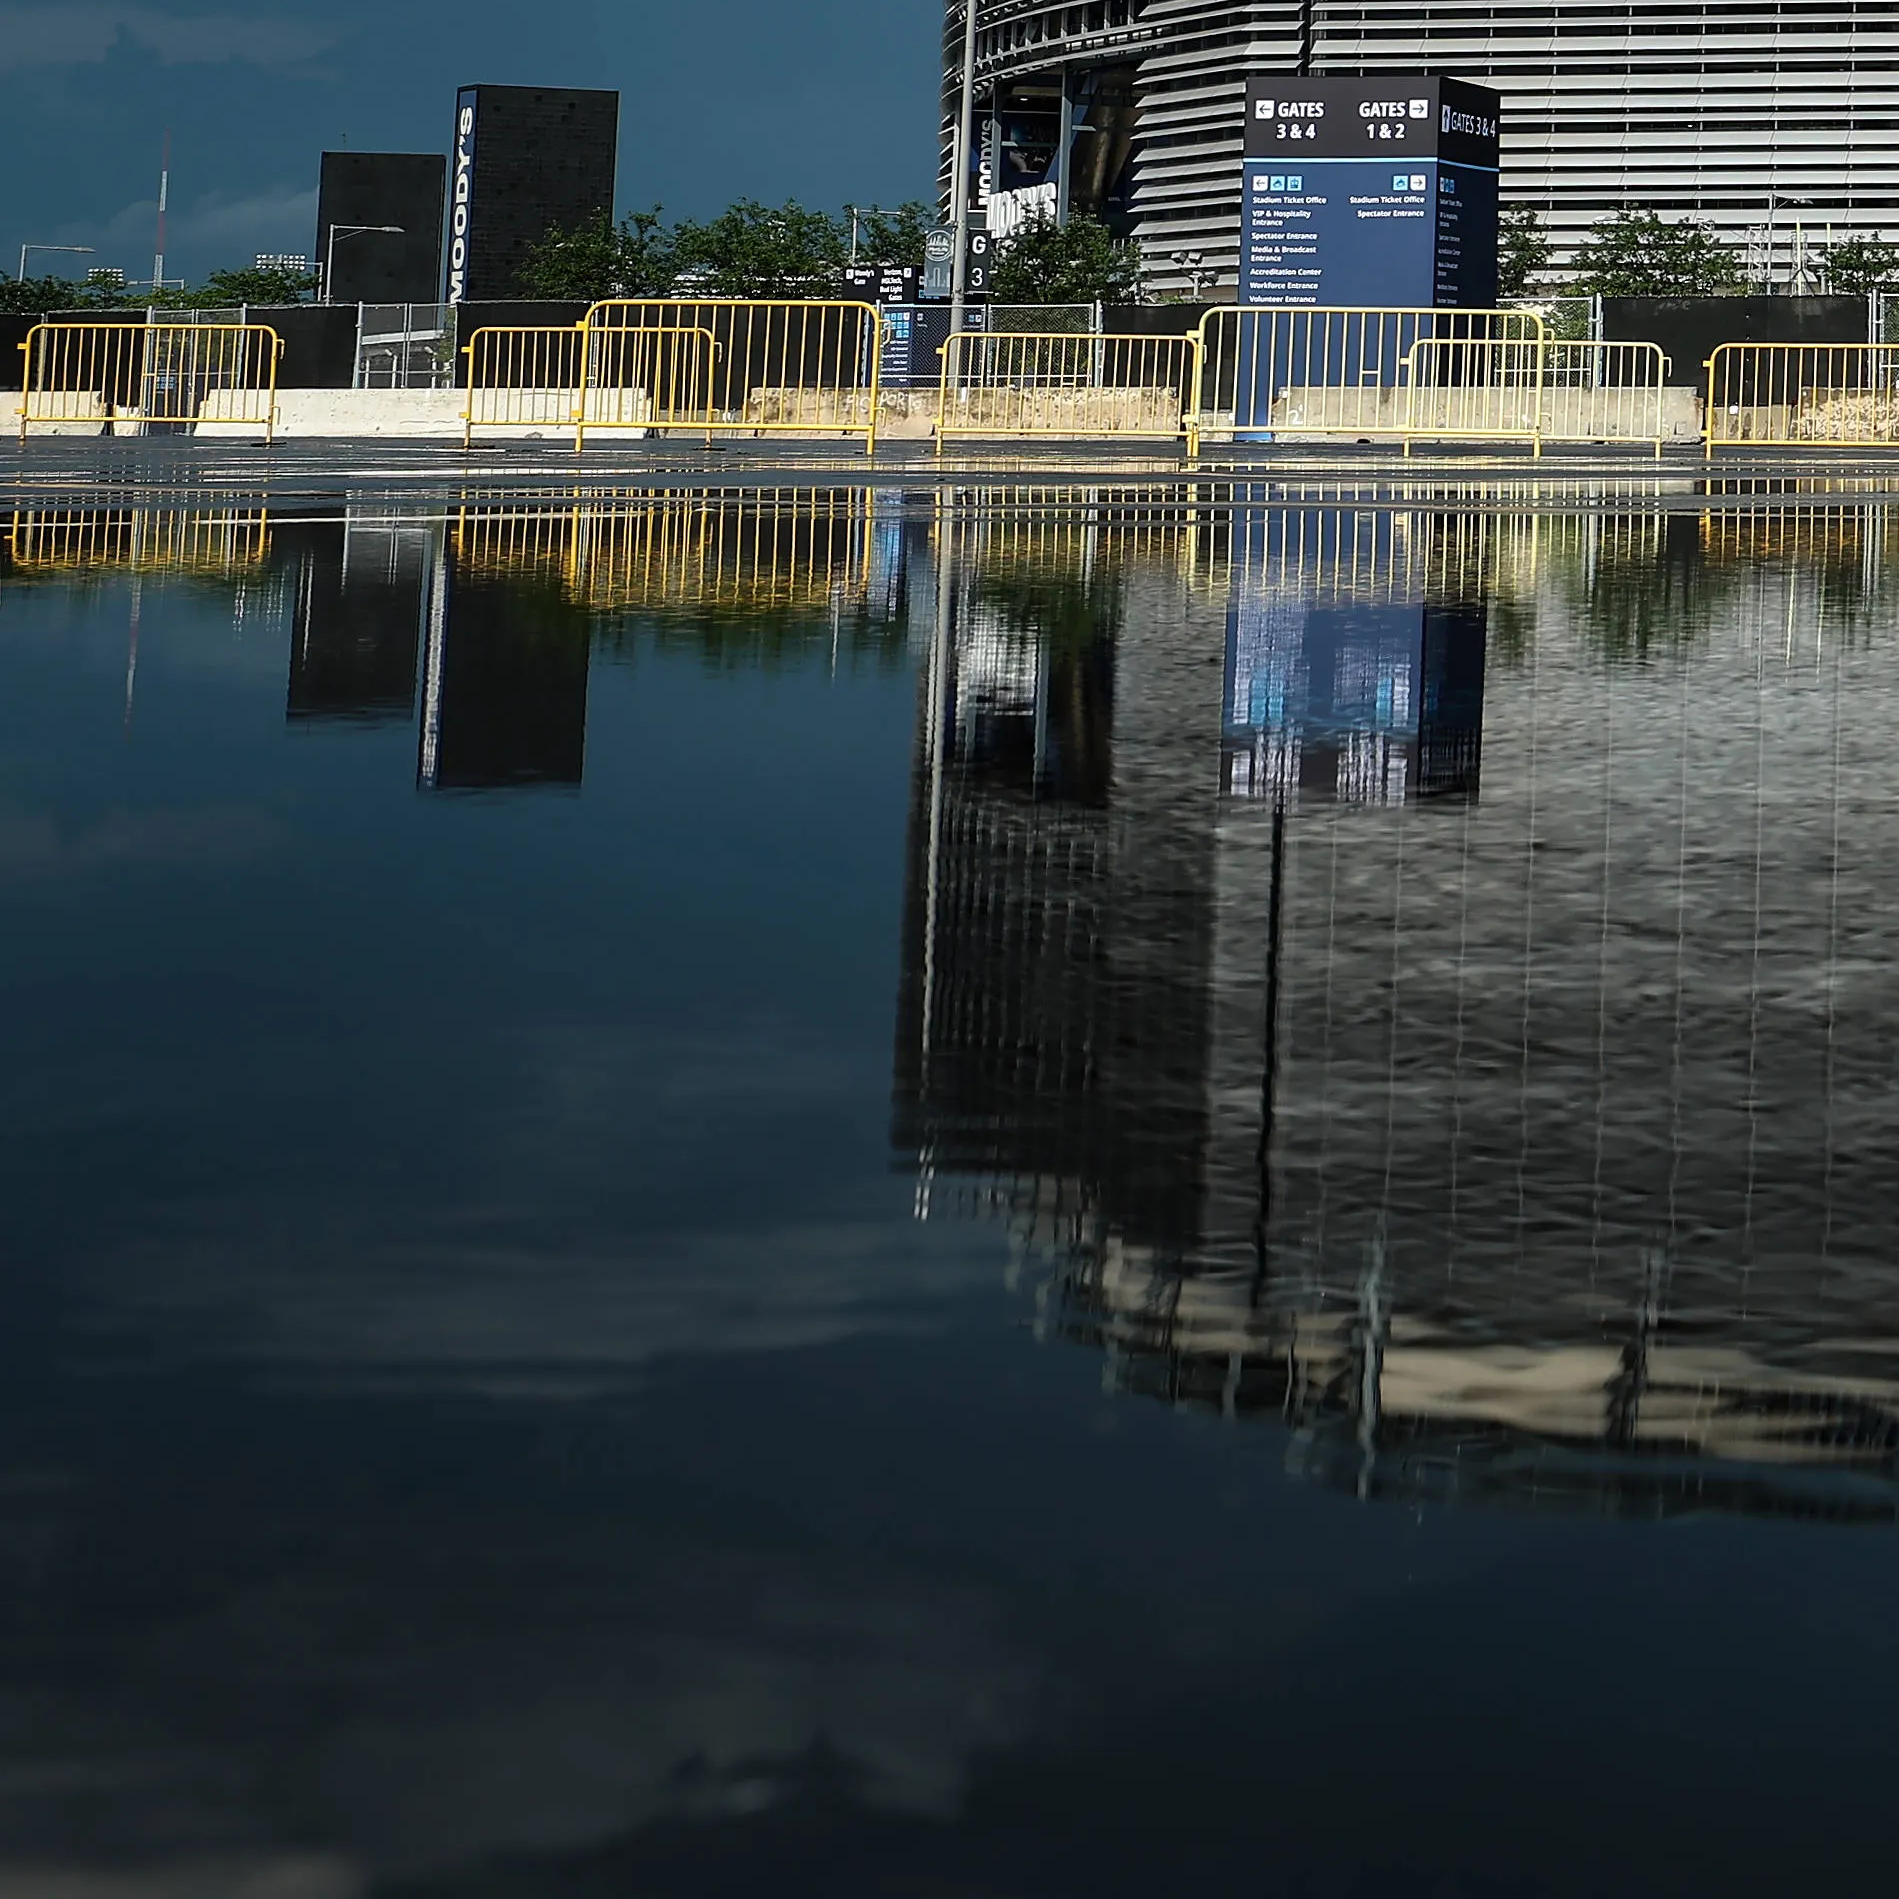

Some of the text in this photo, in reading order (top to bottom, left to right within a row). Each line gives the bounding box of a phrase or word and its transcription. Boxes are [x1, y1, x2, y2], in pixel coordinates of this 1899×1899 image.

[1277, 101, 1325, 118] GATES
[1359, 101, 1406, 118] GATES
[1276, 123, 1316, 139] 3 & 4
[1366, 123, 1406, 139] 1 & 2
[1451, 112, 1496, 138] GATES 3 & 4
[1252, 196, 1327, 204] Stadium Ticket Office
[1349, 196, 1425, 204] Stadium Ticket Office
[1251, 232, 1318, 240] Spectator Entrance
[972, 235, 987, 254] G
[971, 267, 983, 287] 3
[1297, 268, 1322, 276] Center
[1284, 295, 1317, 303] Entrance
